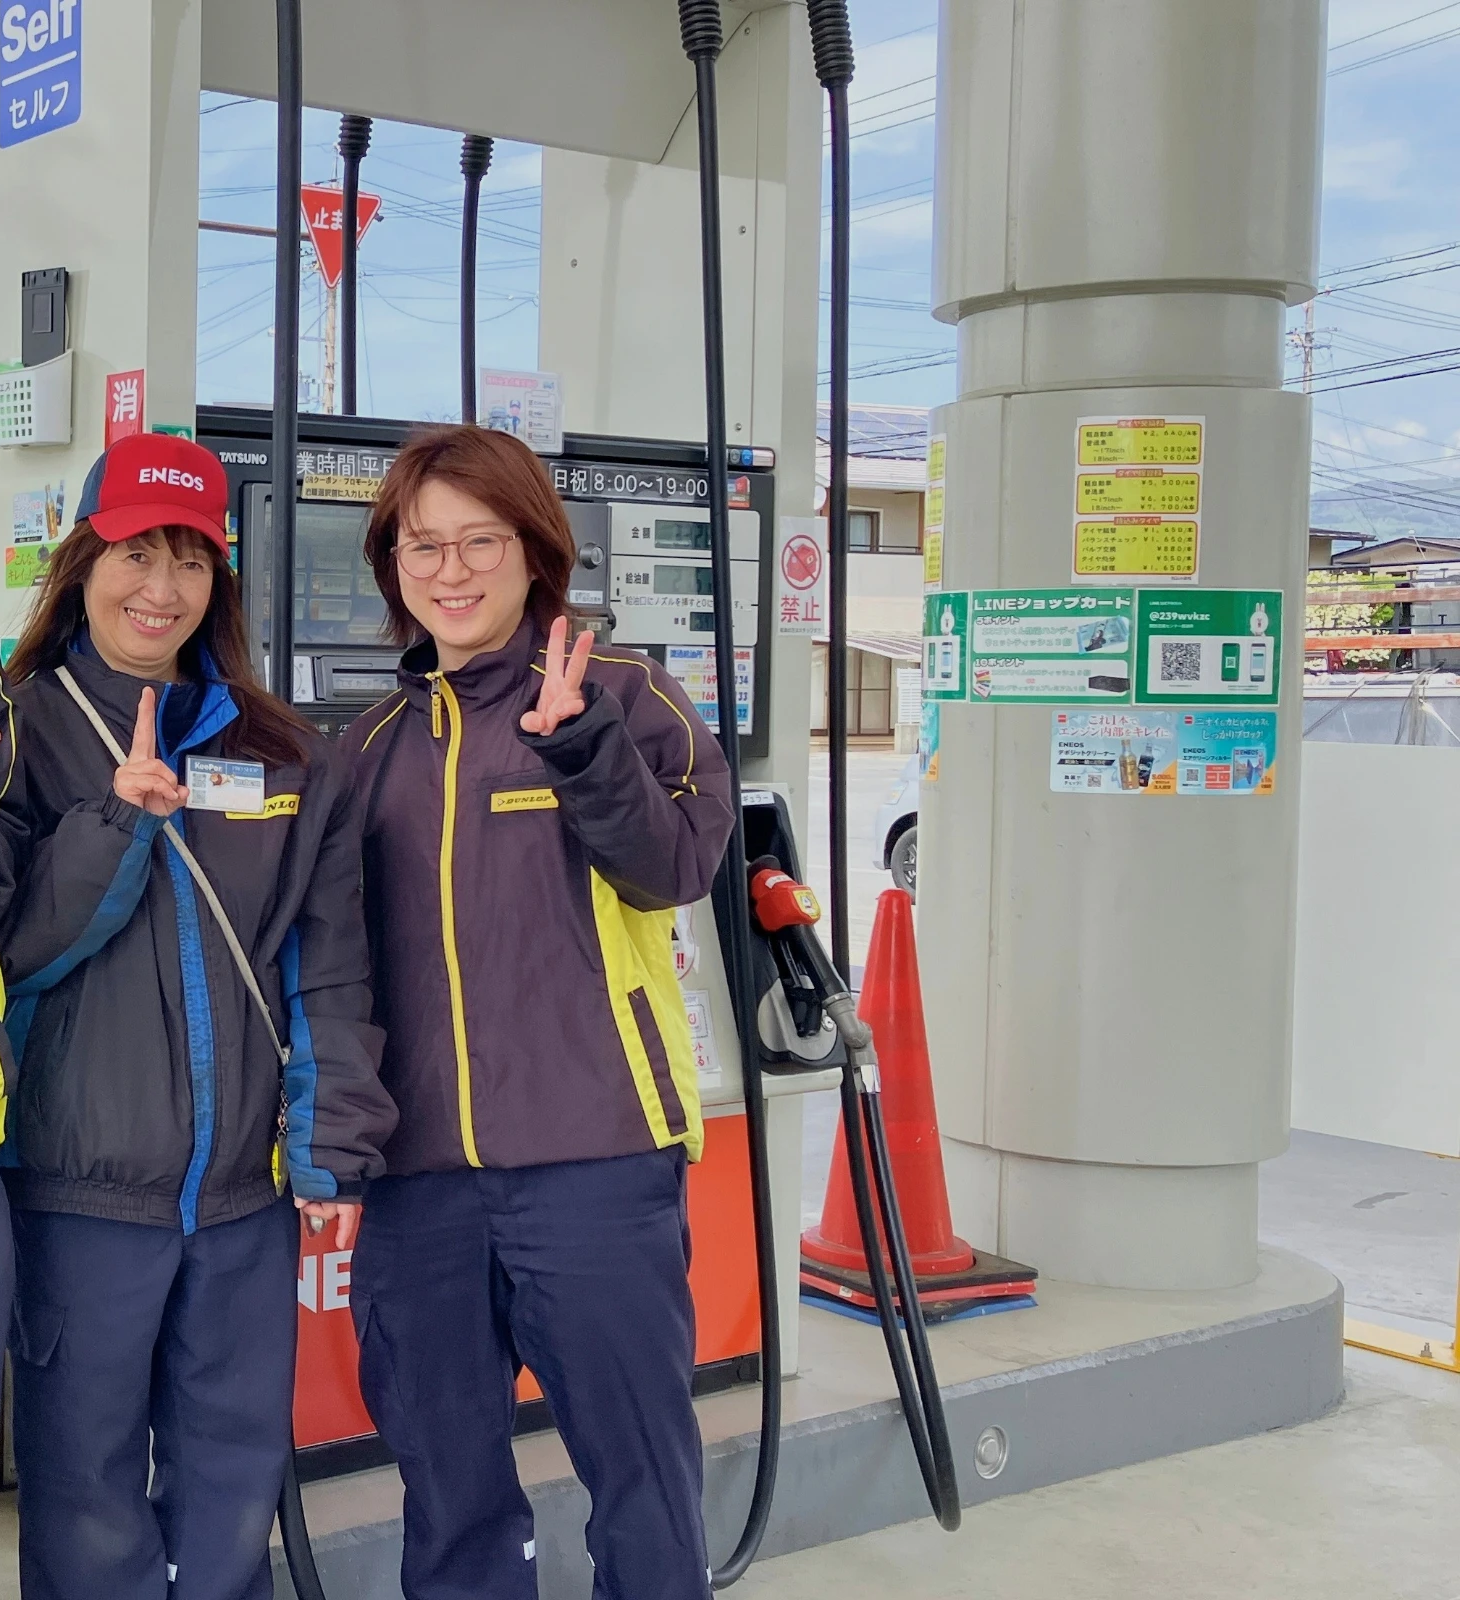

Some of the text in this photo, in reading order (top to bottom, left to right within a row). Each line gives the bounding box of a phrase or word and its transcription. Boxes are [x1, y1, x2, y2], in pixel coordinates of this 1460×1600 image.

[2, 0, 77, 62] Self
[9, 81, 69, 129] セルフ
[312, 206, 362, 232] 止ま
[112, 378, 138, 423] 消
[219, 451, 268, 465] TATSUNO
[296, 451, 355, 477] 業時間
[139, 467, 205, 492] ENEOS
[554, 468, 587, 493] 日祝
[631, 526, 651, 539] 金額
[625, 573, 650, 585] 給油量
[780, 595, 822, 623] 禁止
[973, 595, 1131, 611] LINEショップカード
[976, 615, 1020, 626] 5ポイント
[975, 658, 1024, 668] 10ポイント
[703, 674, 717, 684] 169
[702, 691, 748, 701] 166 33
[737, 708, 747, 718] 32
[1059, 727, 1170, 738] エンジン内部をキレイに
[194, 761, 222, 772] KeePer
[264, 800, 296, 813] NLO
[506, 795, 552, 805] DUNLOP
